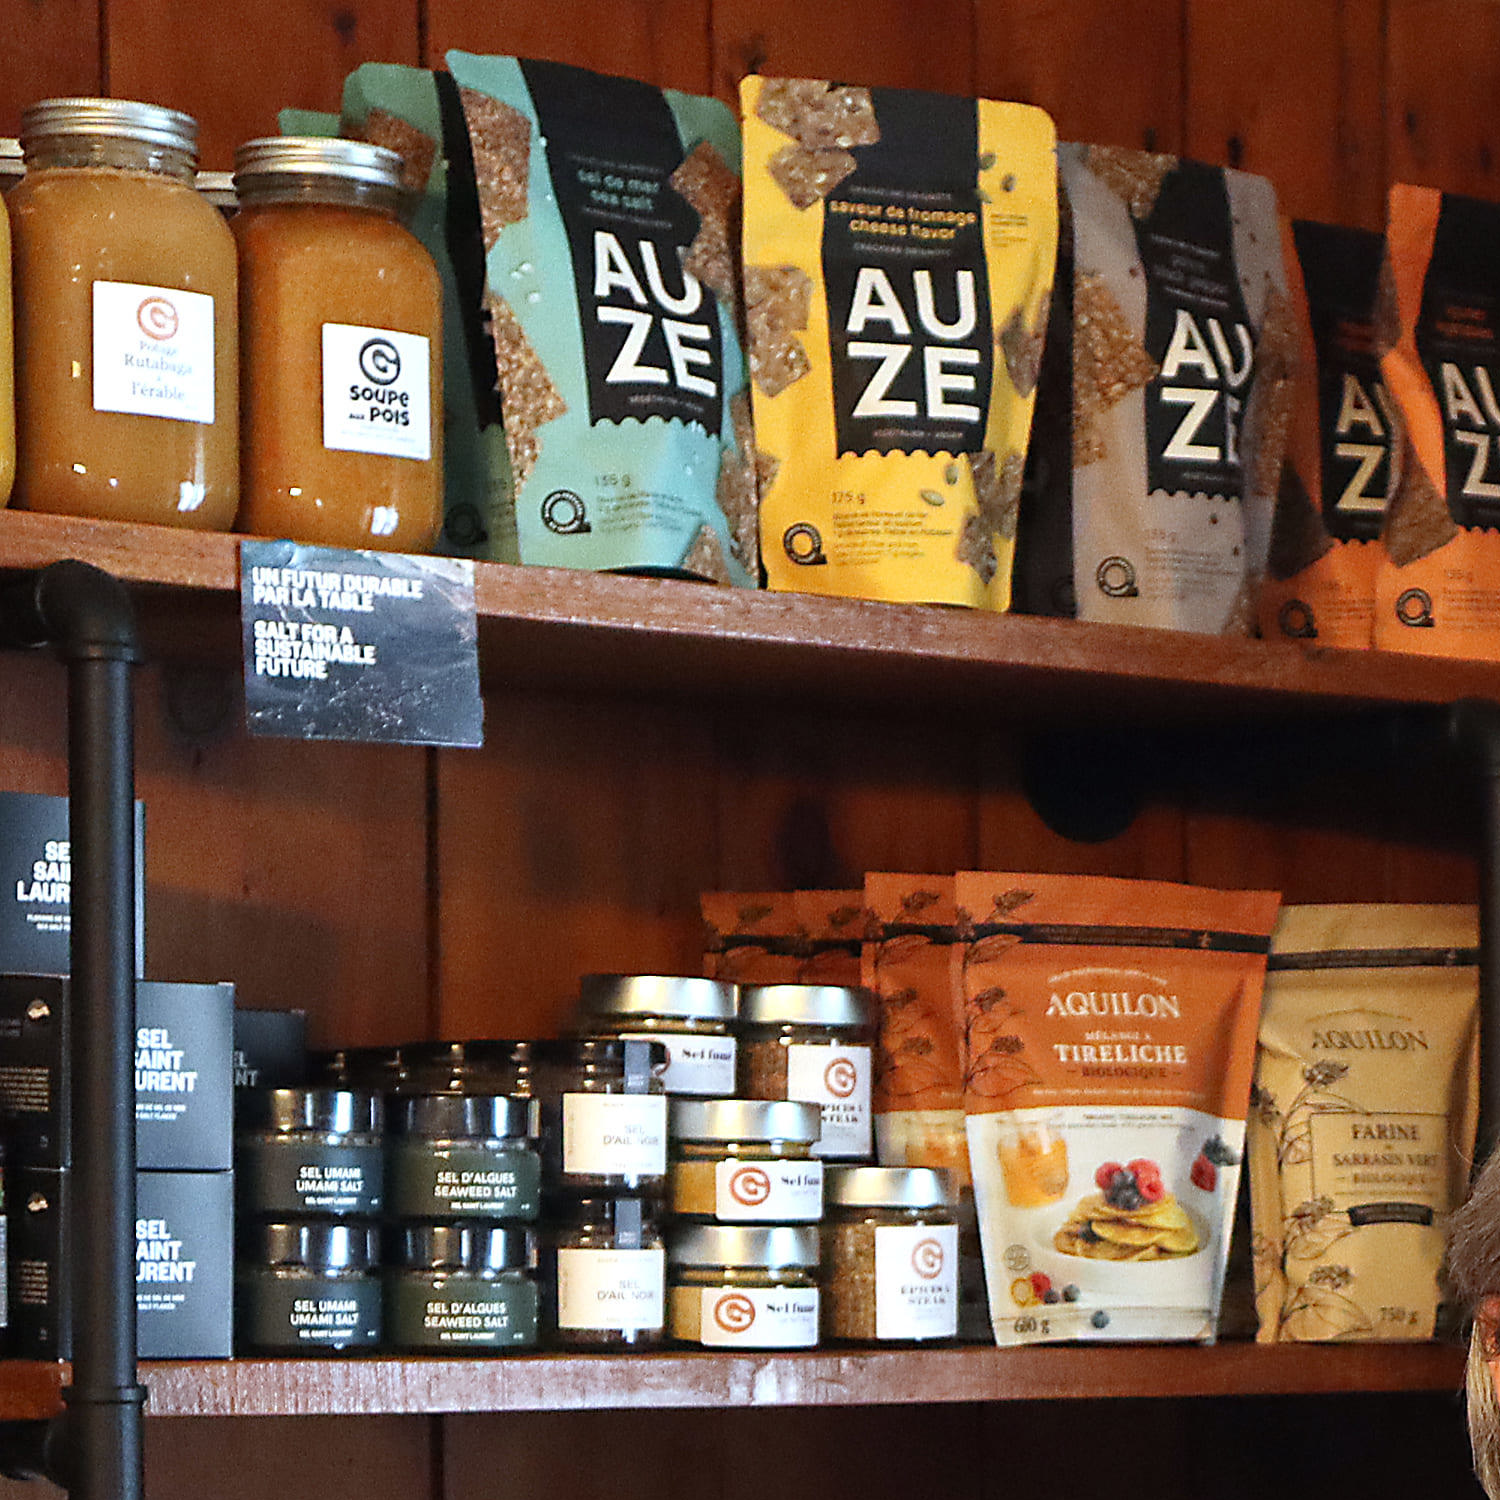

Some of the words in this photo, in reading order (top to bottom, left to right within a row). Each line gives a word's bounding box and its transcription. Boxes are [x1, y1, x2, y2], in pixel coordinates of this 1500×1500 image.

[849, 218, 907, 236] cheese
[907, 206, 976, 227] fromage
[594, 231, 702, 315] AU
[846, 267, 977, 340] AU
[597, 305, 717, 397] ZE
[1160, 308, 1254, 387] AU
[847, 341, 980, 421] ZE
[252, 567, 280, 586] UN
[281, 569, 341, 591] FUTUR
[343, 574, 424, 599] DURABLE
[253, 585, 290, 605] PAR
[292, 588, 316, 608] LA
[318, 590, 375, 612] TABLE
[254, 620, 299, 640] SALT
[301, 622, 338, 643] FOR
[339, 627, 355, 645] A
[255, 638, 377, 665] SUSTAINABLE
[256, 656, 329, 680] FUTURE
[45, 841, 71, 861] SE
[33, 861, 71, 882] SAI
[16, 880, 71, 903] LAUR
[1045, 990, 1181, 1018] AQUILON
[137, 1027, 173, 1049] SEL
[1311, 1029, 1429, 1052] AQUILON
[135, 1049, 184, 1071] AINT
[1053, 1043, 1188, 1065] TIRELICHE
[135, 1071, 198, 1092] URENT
[1351, 1123, 1421, 1141] FARINE
[300, 1166, 322, 1179] SEL
[324, 1166, 361, 1180] UMAMI
[437, 1171, 459, 1184] SEL
[461, 1171, 516, 1184] D'ALGUES
[296, 1179, 338, 1192] UMAMI
[340, 1180, 364, 1192] SALT
[434, 1185, 492, 1198] SEAWEED
[494, 1186, 518, 1198] SALT
[136, 1219, 171, 1240] SEL
[136, 1240, 182, 1260] AINT
[294, 1299, 316, 1312] SEL
[318, 1299, 357, 1312] UMAMI
[427, 1302, 449, 1314] SEL
[450, 1302, 507, 1314] D'ALGUES
[290, 1313, 333, 1325] UMAMI
[334, 1313, 359, 1325] SALT
[424, 1315, 482, 1328] SEAWEED
[484, 1316, 509, 1328] SALT
